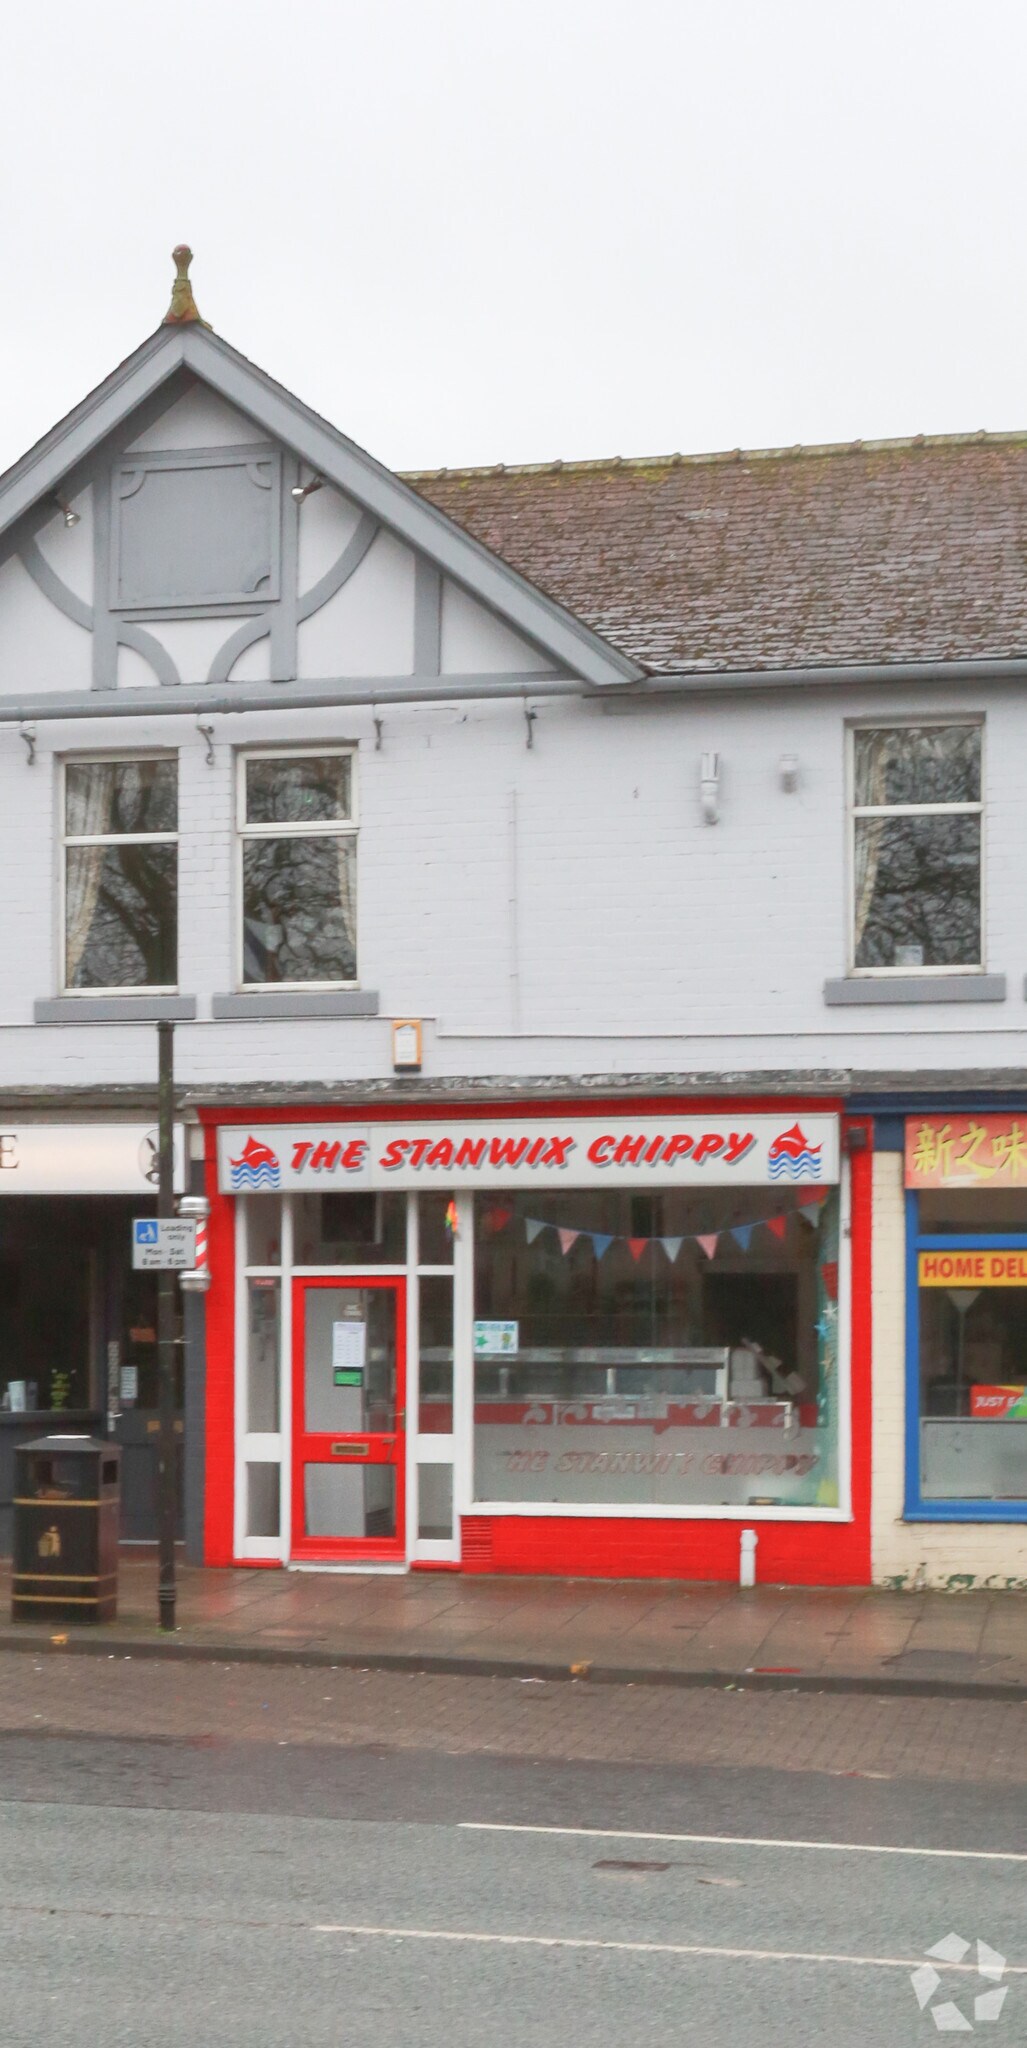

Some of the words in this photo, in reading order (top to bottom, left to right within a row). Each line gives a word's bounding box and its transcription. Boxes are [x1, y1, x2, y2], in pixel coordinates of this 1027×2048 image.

[291, 1139, 369, 1173] THE
[379, 1135, 576, 1170] STANWIX
[587, 1131, 757, 1168] CHIPPY
[912, 1122, 1027, 1180] 新之味
[160, 1224, 193, 1233] Loading
[167, 1234, 186, 1242] only
[145, 1248, 162, 1256] Mon
[170, 1248, 184, 1256] Sat
[924, 1257, 985, 1278] HOME
[975, 1396, 1006, 1408] JUST
[497, 1449, 550, 1474] HE
